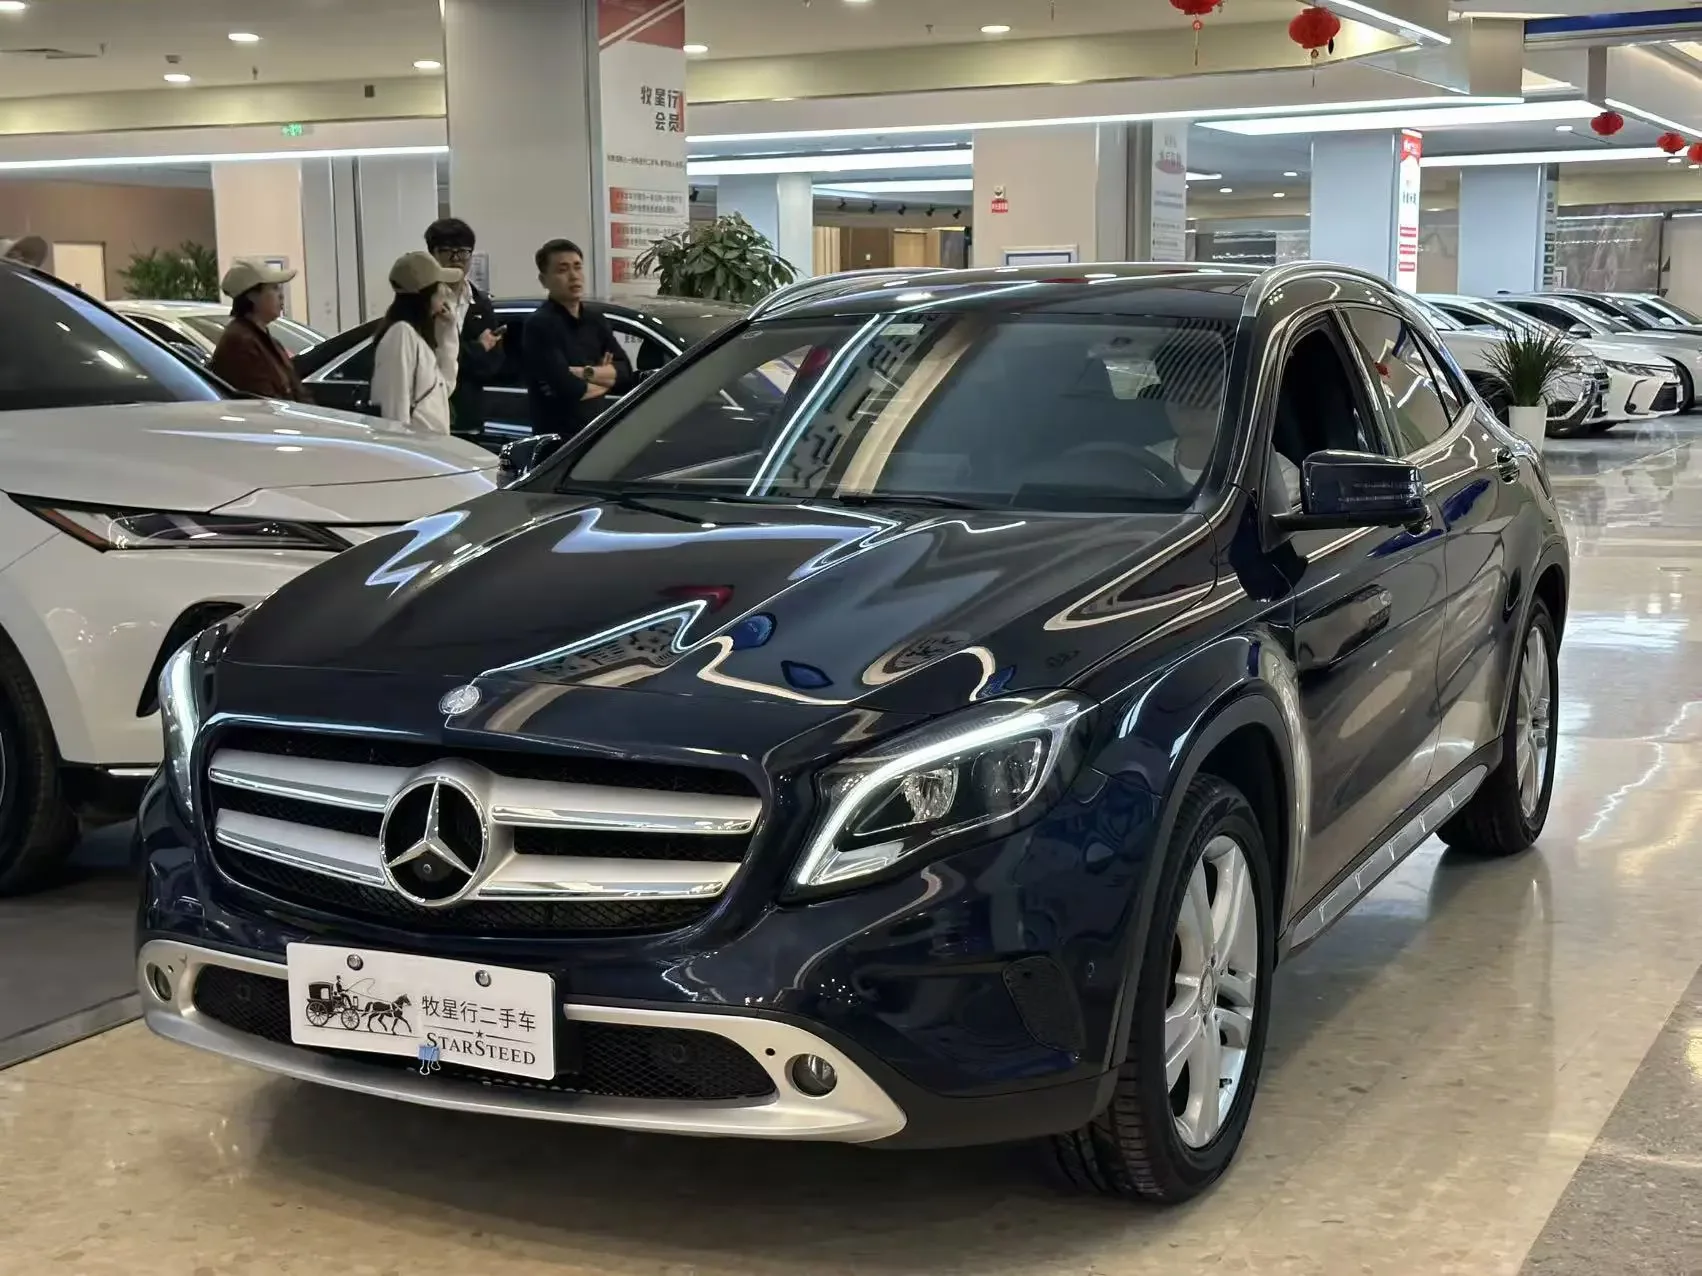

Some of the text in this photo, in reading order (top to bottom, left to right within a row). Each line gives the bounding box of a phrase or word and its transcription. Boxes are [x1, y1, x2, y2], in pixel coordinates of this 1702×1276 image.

[640, 85, 678, 108] 牧星行
[655, 112, 680, 132] 会员
[421, 995, 536, 1032] 牧星行二手车
